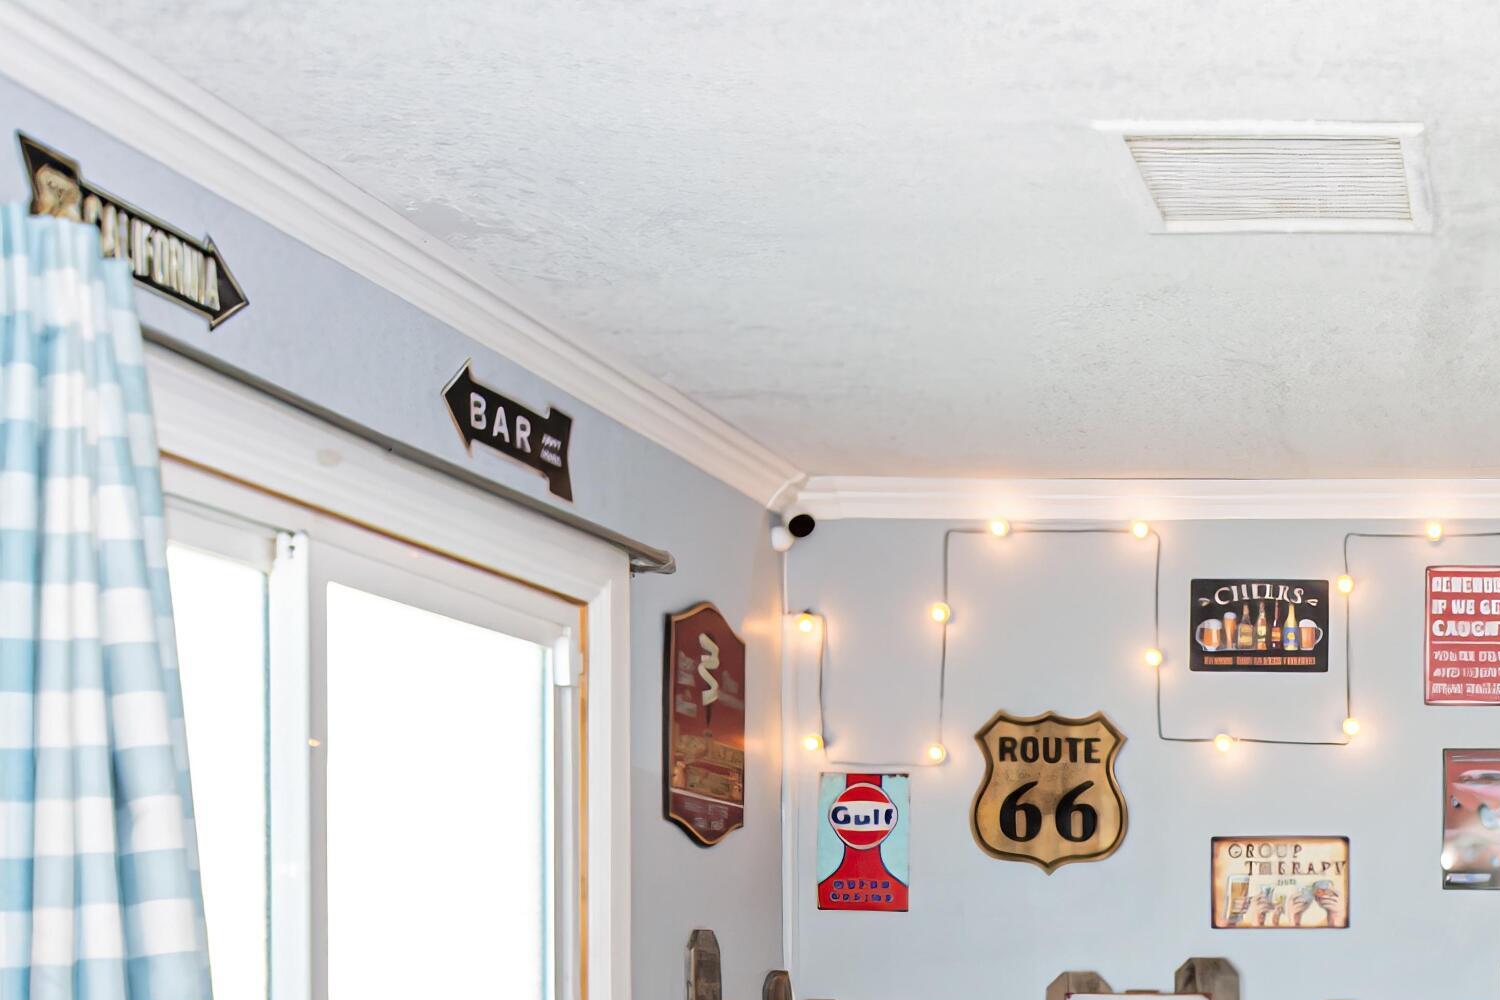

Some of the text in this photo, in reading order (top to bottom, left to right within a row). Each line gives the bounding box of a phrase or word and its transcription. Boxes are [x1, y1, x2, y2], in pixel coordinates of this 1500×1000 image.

[470, 391, 532, 454] BAR
[1431, 599, 1447, 615] IF
[999, 736, 1101, 763] ROUTE
[1000, 780, 1098, 843] 66
[1228, 842, 1303, 859] GROUP
[1244, 860, 1347, 876] THERAPY
